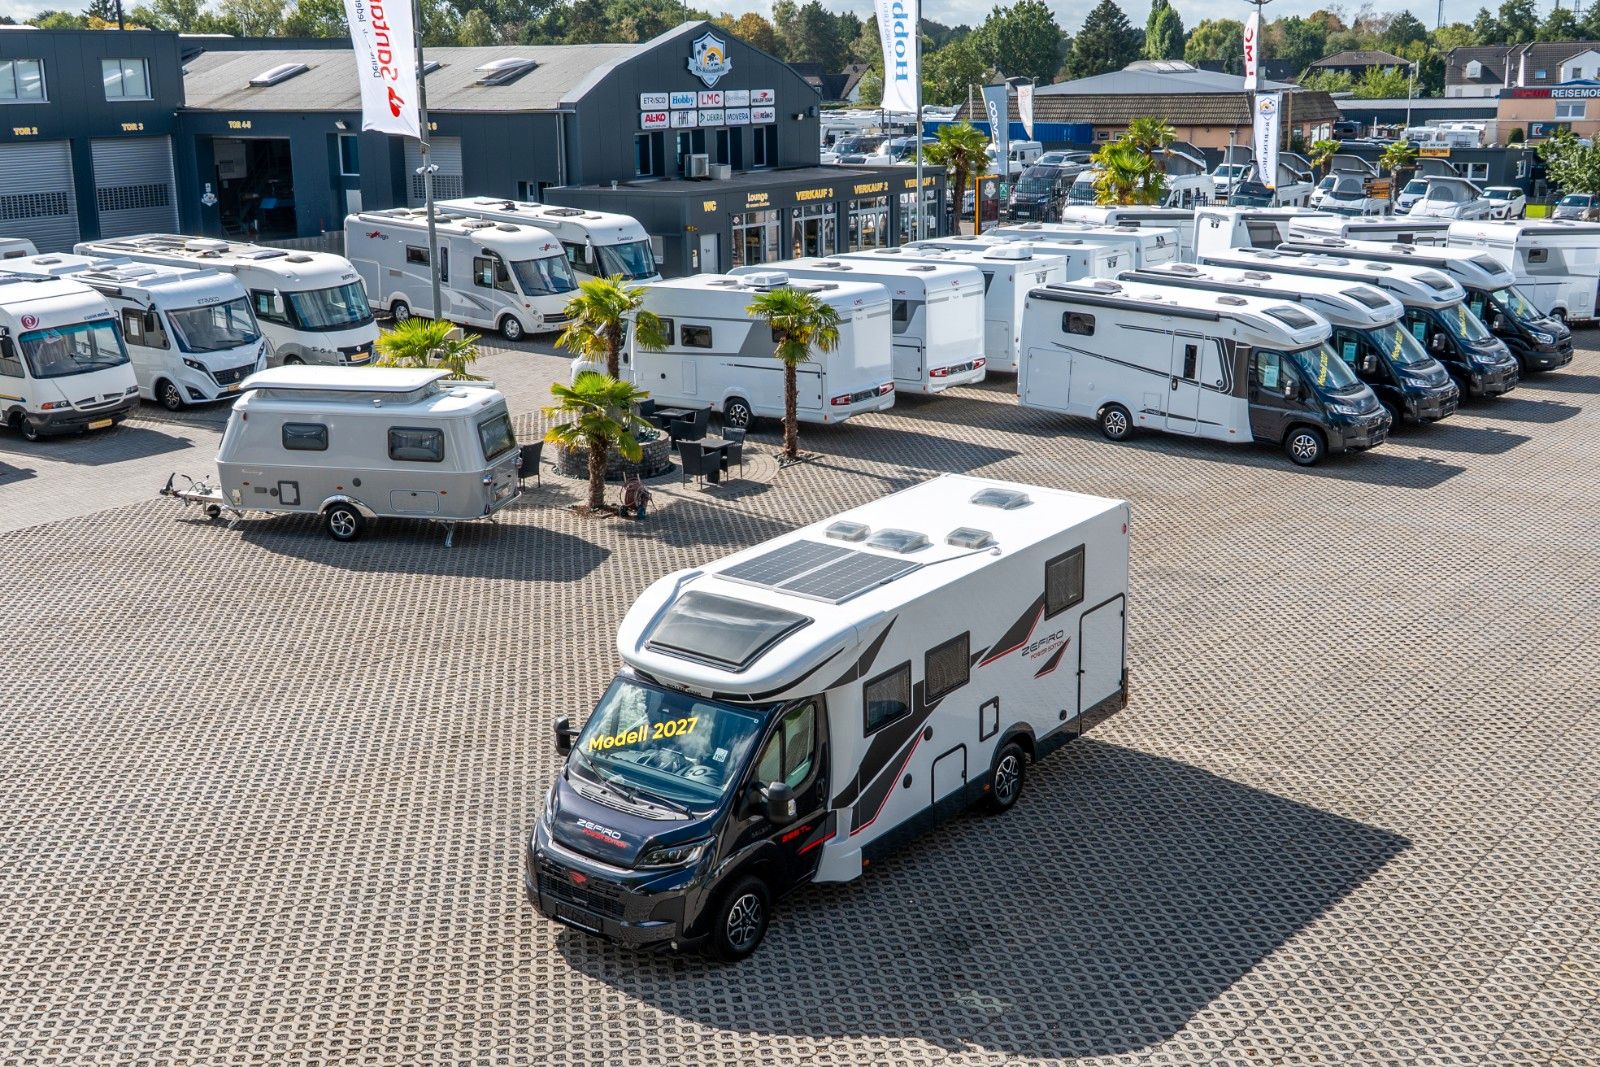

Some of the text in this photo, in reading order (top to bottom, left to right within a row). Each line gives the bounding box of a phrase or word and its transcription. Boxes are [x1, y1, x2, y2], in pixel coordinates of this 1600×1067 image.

[672, 94, 695, 107] Hobby
[701, 93, 720, 106] LMC
[121, 123, 144, 132] TOR 3
[228, 121, 241, 129] TOR
[13, 127, 38, 136] TOR 2
[796, 187, 834, 201] VERKAUF 3
[854, 182, 889, 194] VERKAUF 2
[747, 192, 769, 202] Lounge
[703, 201, 717, 212] WC
[1021, 630, 1064, 657] ZEFIRO
[588, 716, 698, 752] Modell 2027
[576, 818, 622, 840] ZEFIRO
